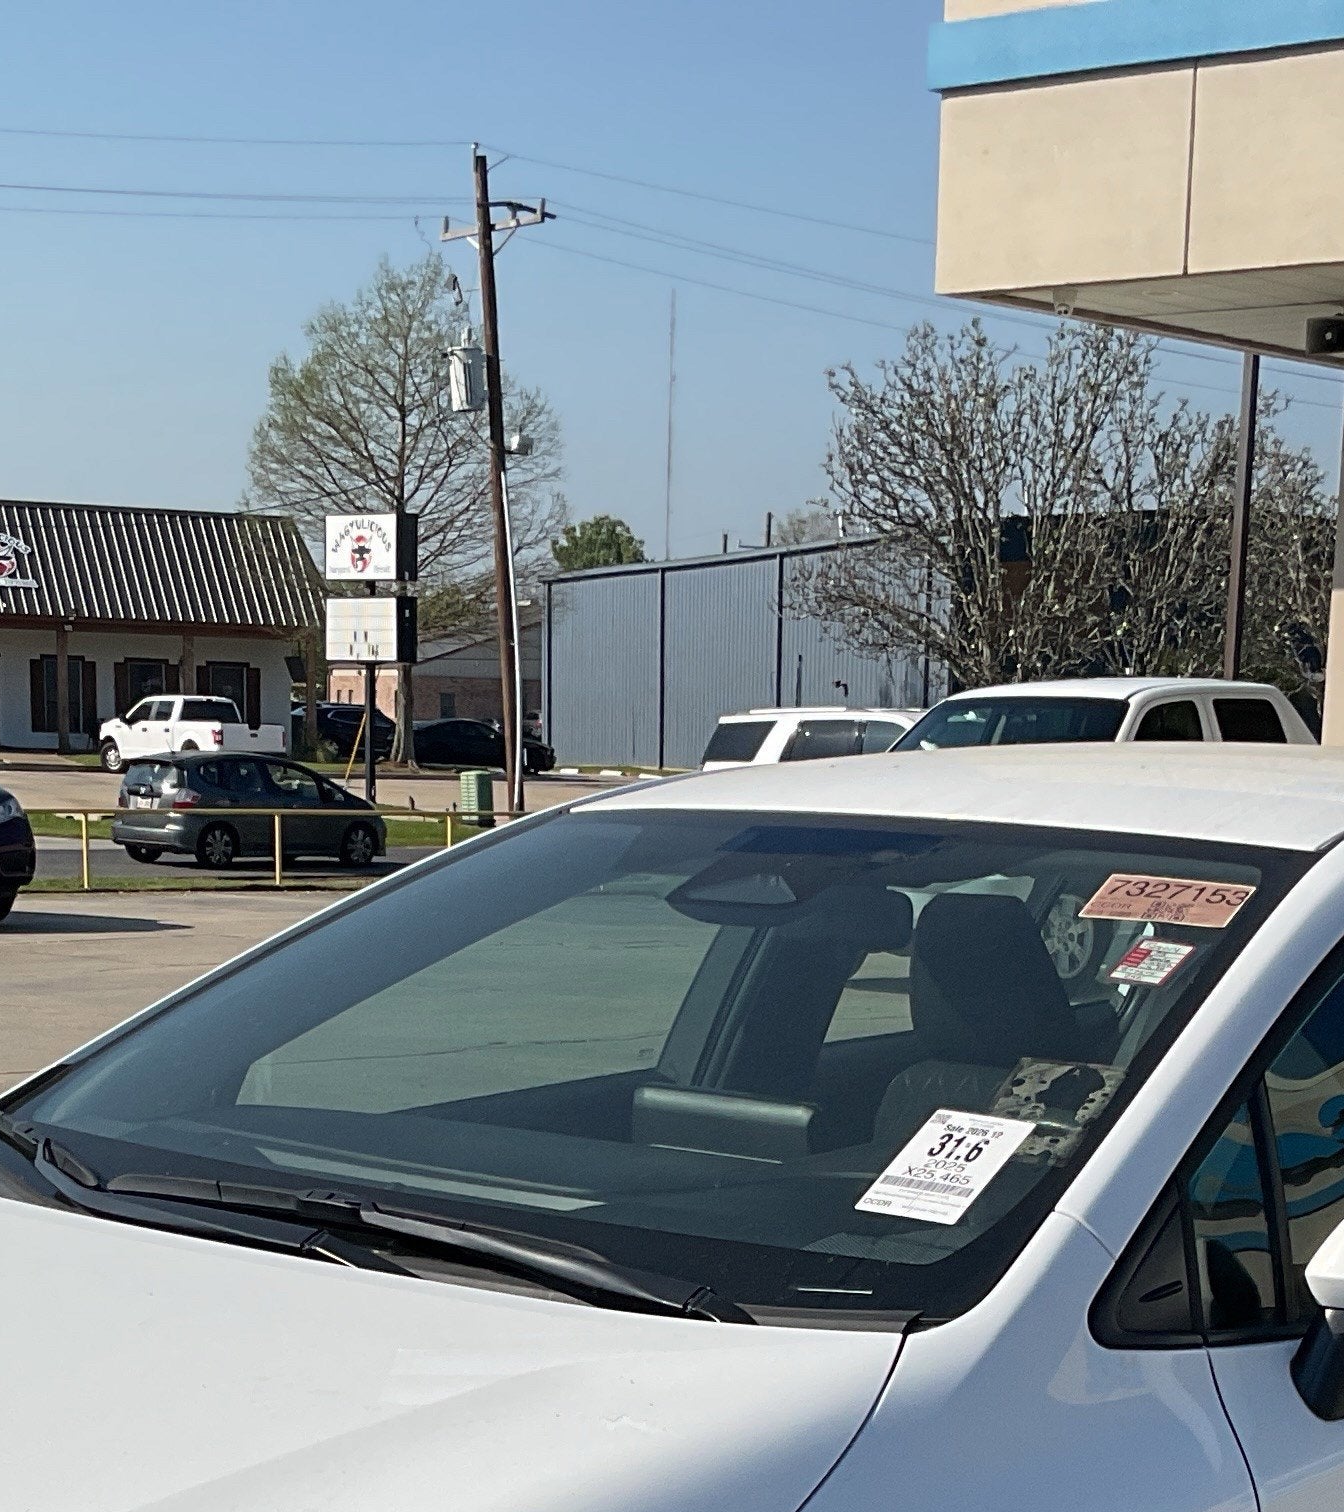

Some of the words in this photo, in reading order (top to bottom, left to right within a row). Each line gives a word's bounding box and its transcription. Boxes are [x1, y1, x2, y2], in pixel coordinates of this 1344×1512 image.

[1108, 880, 1250, 907] 7327153
[943, 1123, 965, 1134] Sale
[923, 1158, 968, 1173] 2025
